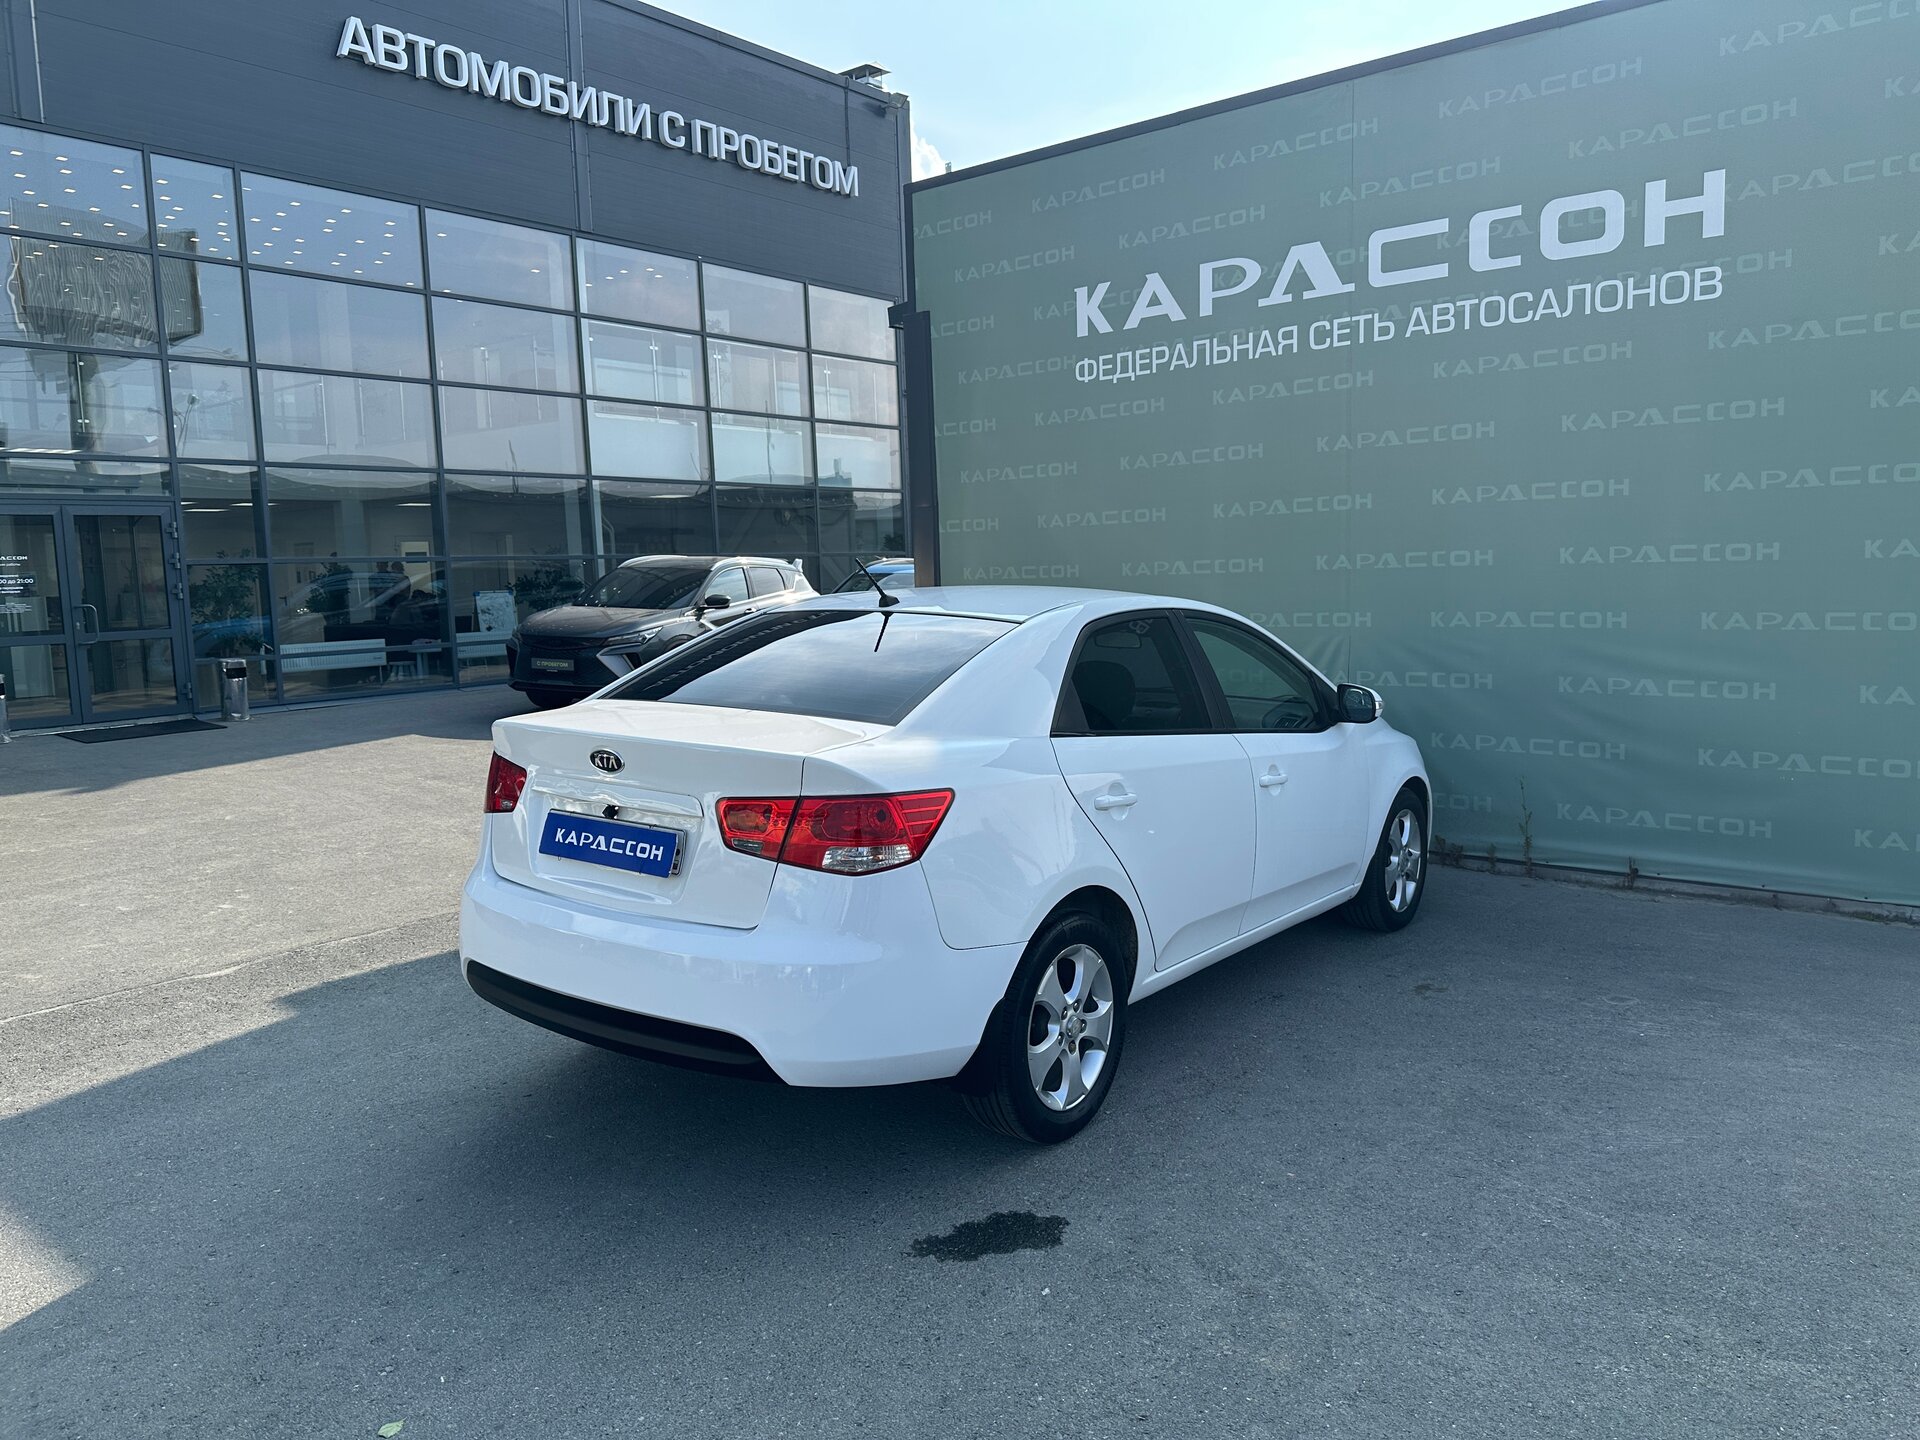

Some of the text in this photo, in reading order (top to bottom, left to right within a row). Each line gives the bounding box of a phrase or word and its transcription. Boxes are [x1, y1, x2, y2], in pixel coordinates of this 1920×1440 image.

[336, 16, 860, 198] АВТОМОБИЛИ С ПРОБЕГОМ
[1075, 265, 1724, 384] ФЕДЕРАЛЬНАЯ СЕТЬ АВТОСАЛОНОВ
[593, 753, 619, 770] KIA
